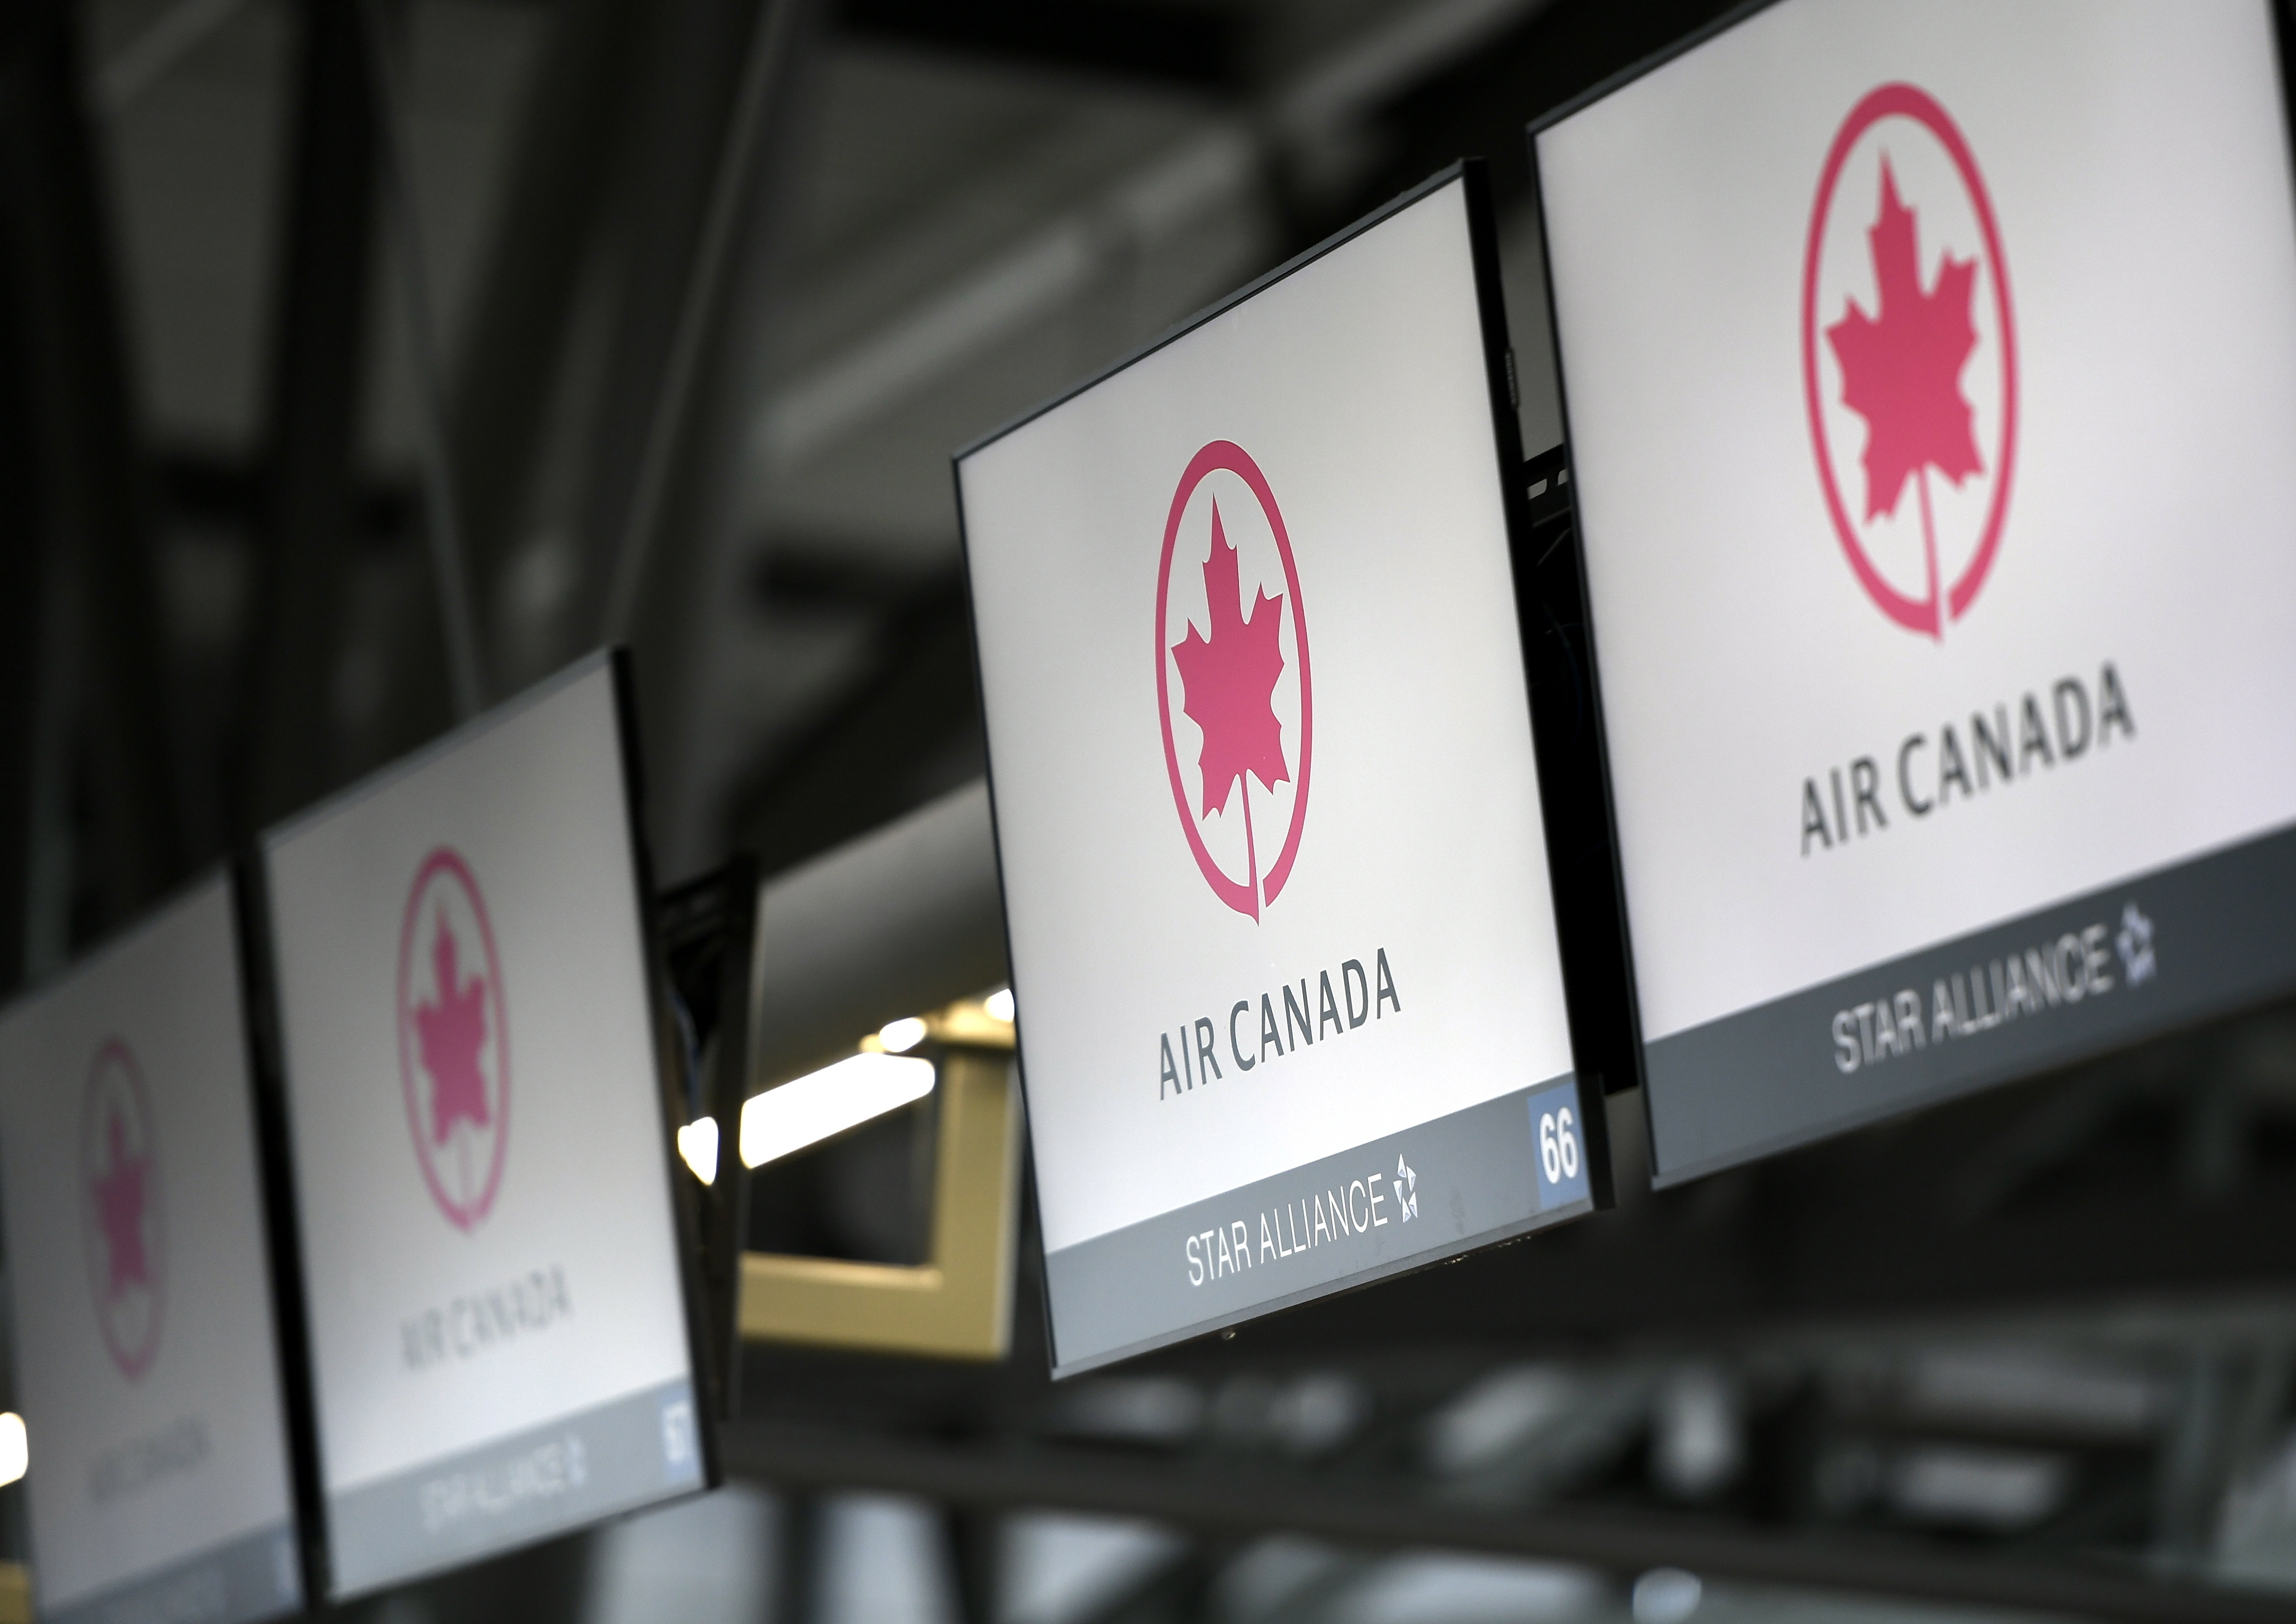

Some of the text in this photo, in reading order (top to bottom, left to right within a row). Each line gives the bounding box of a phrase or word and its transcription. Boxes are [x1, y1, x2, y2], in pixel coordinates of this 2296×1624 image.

[1800, 659, 2137, 858] AIR CANADA
[1160, 947, 1401, 1101] AIR CANADA
[1831, 923, 2114, 1074] STAR ALLIANCE
[1539, 1106, 1580, 1184] 66
[1186, 1173, 1389, 1286] STAR ALLIANCE
